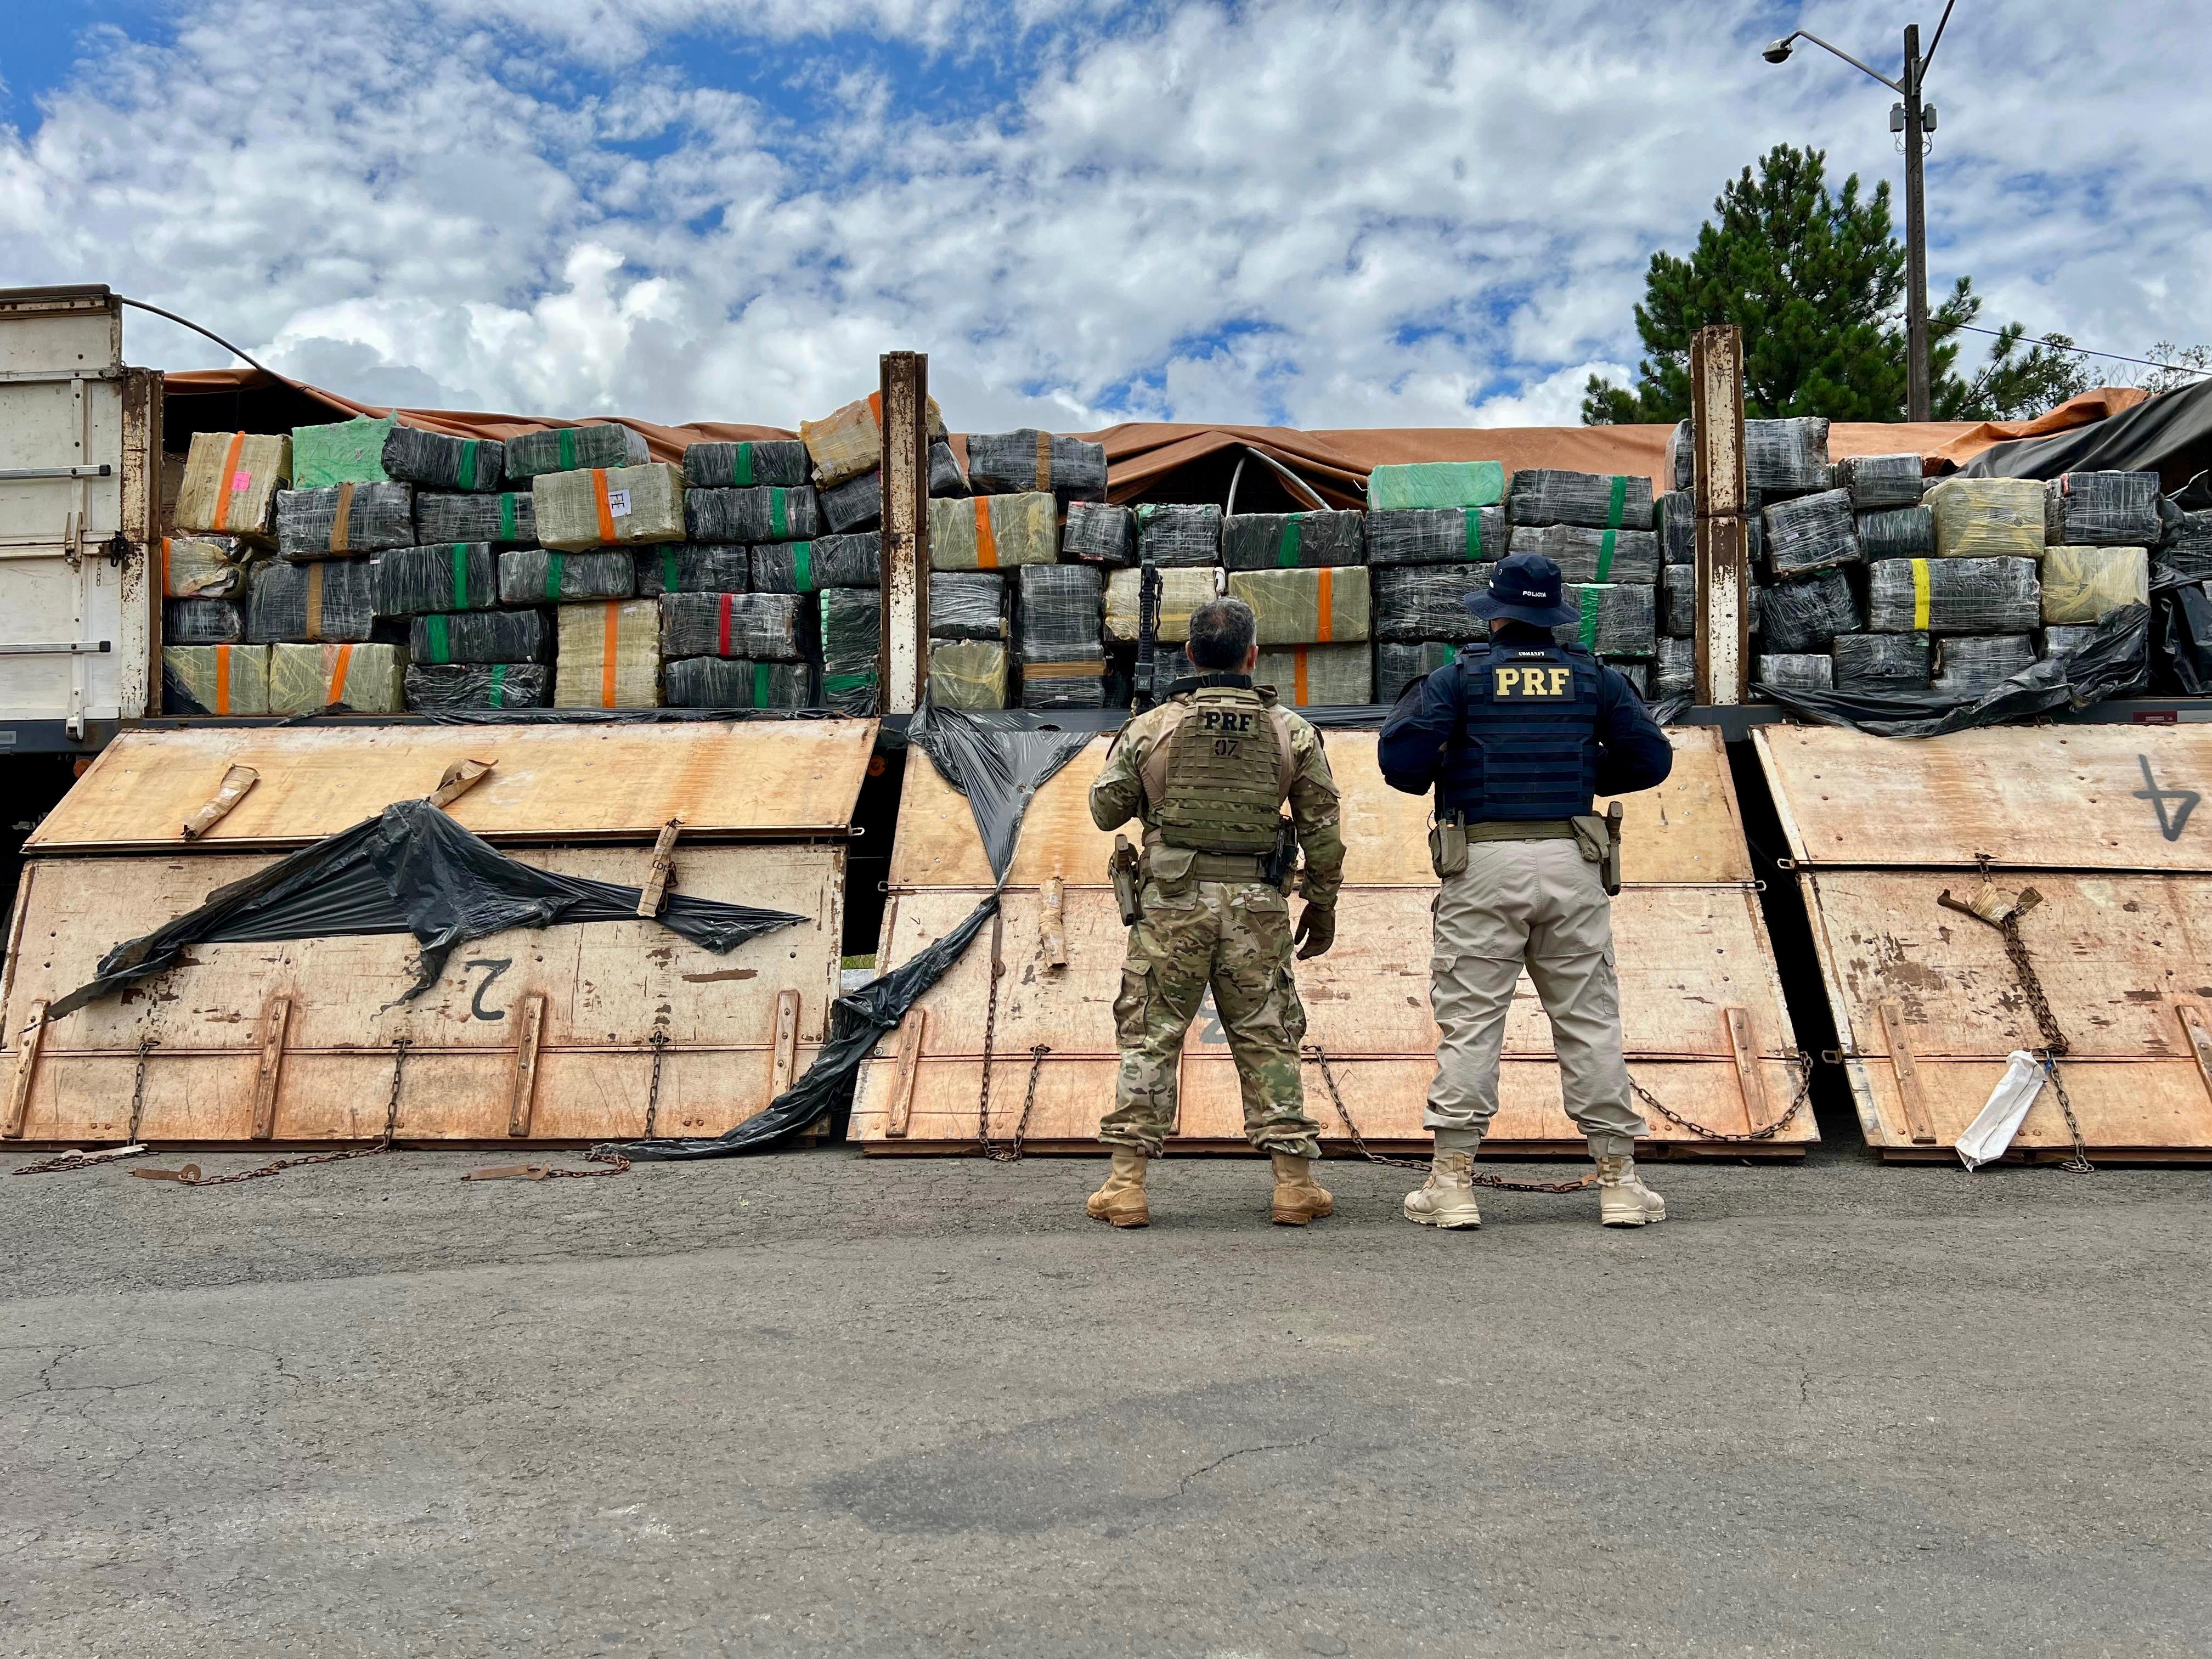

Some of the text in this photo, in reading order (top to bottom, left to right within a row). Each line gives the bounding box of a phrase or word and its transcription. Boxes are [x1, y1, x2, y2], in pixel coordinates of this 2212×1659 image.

[1496, 668, 1570, 696] PRF
[1204, 712, 1253, 732] PRF
[1215, 739, 1239, 756] 07
[2132, 754, 2201, 842] 4
